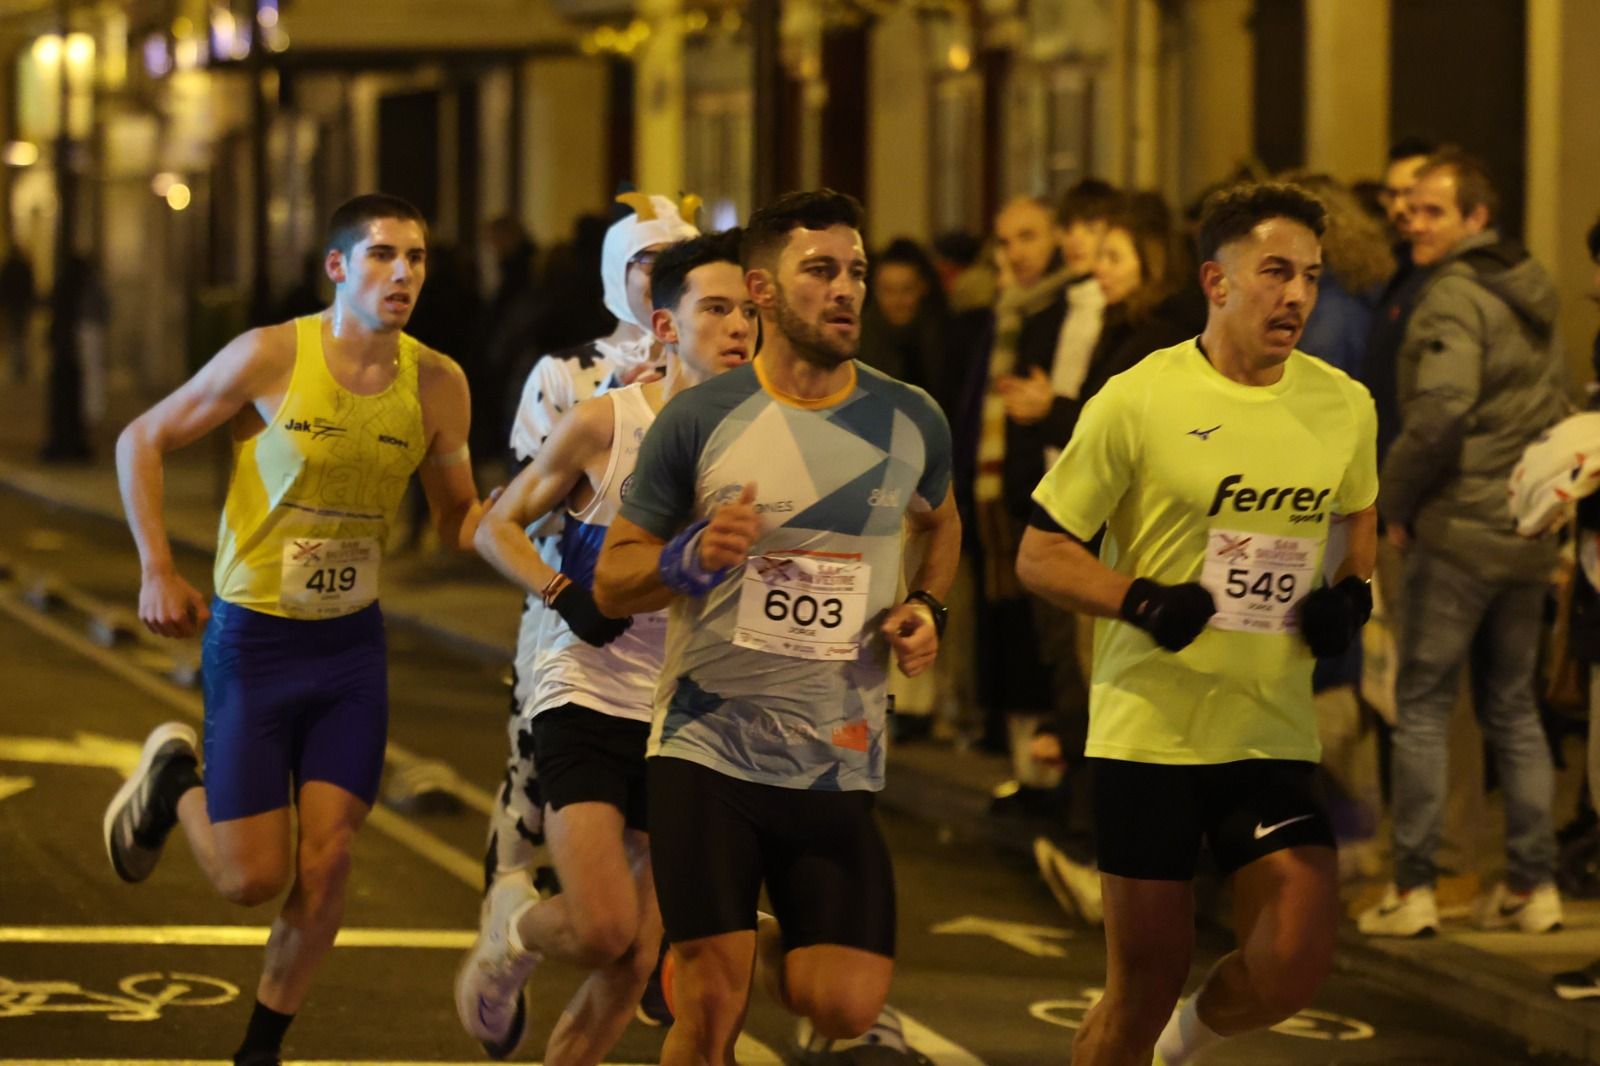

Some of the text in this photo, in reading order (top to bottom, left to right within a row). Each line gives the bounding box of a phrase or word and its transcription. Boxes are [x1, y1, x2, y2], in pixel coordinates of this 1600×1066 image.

[285, 419, 312, 432] Jak
[306, 567, 356, 594] 419
[1226, 569, 1296, 603] 549
[765, 590, 843, 629] 603
